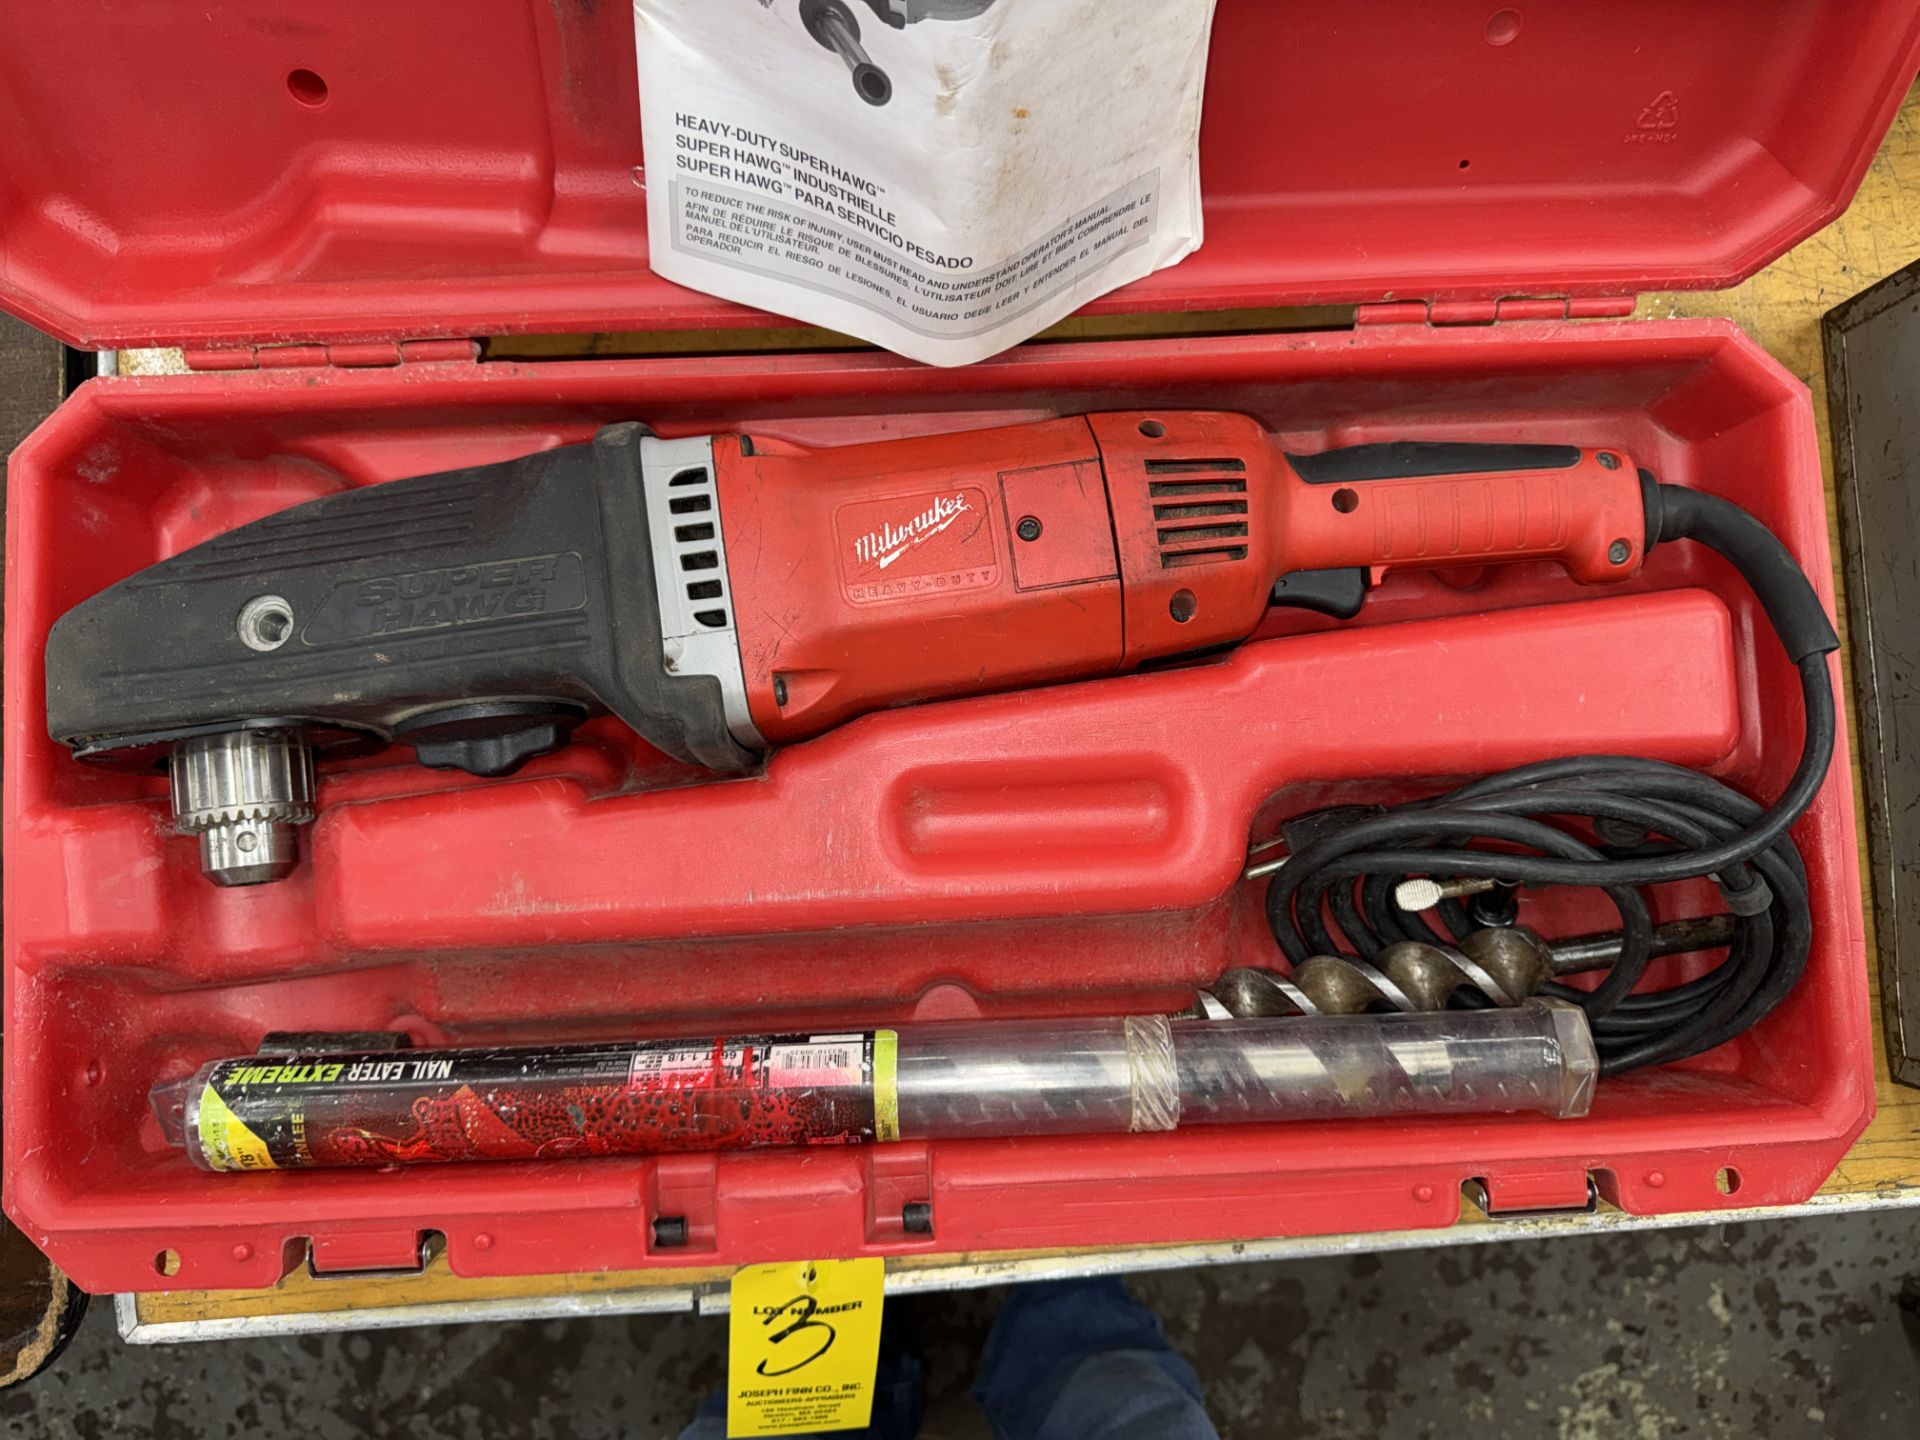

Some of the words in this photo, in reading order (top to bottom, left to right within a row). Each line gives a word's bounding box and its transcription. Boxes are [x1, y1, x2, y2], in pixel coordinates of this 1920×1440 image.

[676, 112, 777, 152] HEAVY-DUTY
[780, 144, 829, 174] SUPER
[676, 135, 730, 159] SUPER
[794, 168, 897, 226] INDUSTRIELLE
[676, 155, 730, 180] SUPER
[795, 188, 835, 214] PARA
[838, 206, 904, 248] SERVICIO
[906, 242, 974, 269] PESADO
[685, 210, 728, 228] MANUEL
[730, 222, 743, 232] DE
[685, 187, 699, 198] TO
[700, 191, 744, 208] REDUCE
[746, 202, 766, 214] THE
[768, 206, 792, 222] RISK
[792, 215, 807, 226] OF
[847, 236, 872, 255] USER
[874, 247, 898, 268] MUST
[899, 264, 925, 284] READ
[926, 276, 950, 290] AND
[952, 262, 1020, 291] UNDERSTAND
[1022, 224, 1074, 266] OPERATOR'S
[686, 202, 709, 214] AFIN
[712, 208, 726, 218] DE
[780, 226, 794, 236] LE
[797, 230, 834, 252] RISQUE
[838, 246, 852, 258] DE
[914, 284, 992, 303] L'UTILISATEUR
[994, 276, 1016, 291] DOIT
[1020, 264, 1040, 279] LIRE
[1042, 254, 1053, 264] ET
[1055, 238, 1076, 255] BIEN
[1077, 201, 1136, 241] COMPRENDRE
[1140, 192, 1152, 205] LE
[686, 224, 713, 238] PARA
[718, 232, 764, 251] REDUCIR
[768, 245, 781, 256] EL
[786, 250, 824, 269] RIESGO
[828, 264, 842, 275] DE
[896, 296, 908, 308] EL
[912, 305, 958, 321] USUARIO
[996, 292, 1019, 309] LEER
[1023, 286, 1030, 296] Y
[1032, 256, 1076, 290] ENTENDER
[1079, 248, 1090, 260] EL
[1094, 227, 1129, 250] MANUAL
[1132, 215, 1150, 230] DEL
[855, 493, 967, 566] Milwaukee
[355, 556, 560, 607] SUPER
[371, 588, 547, 632] HAWG
[224, 1062, 345, 1086] EXTREME
[347, 1061, 406, 1082] EATER
[412, 1060, 454, 1080] NAIL
[753, 1305, 784, 1316] LOT
[790, 1300, 863, 1316] NUMBER
[756, 1294, 836, 1377] 3
[738, 1389, 784, 1399] JOSEPH
[786, 1386, 812, 1396] FINN
